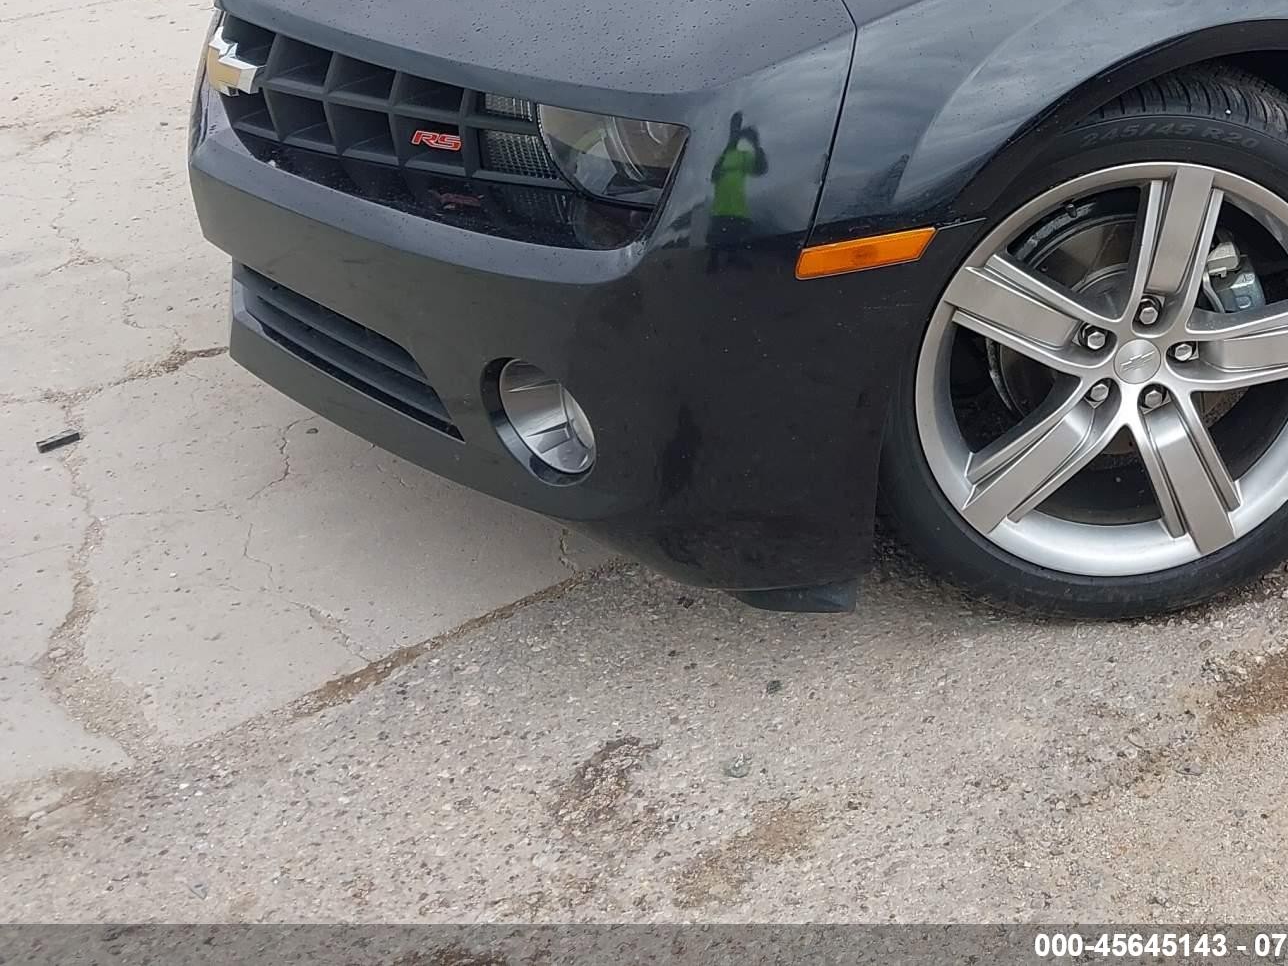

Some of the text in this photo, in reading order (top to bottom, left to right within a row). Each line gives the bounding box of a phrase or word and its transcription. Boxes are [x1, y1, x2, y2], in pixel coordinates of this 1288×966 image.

[411, 130, 462, 151] RS
[1080, 122, 1260, 149] 245/45 R20
